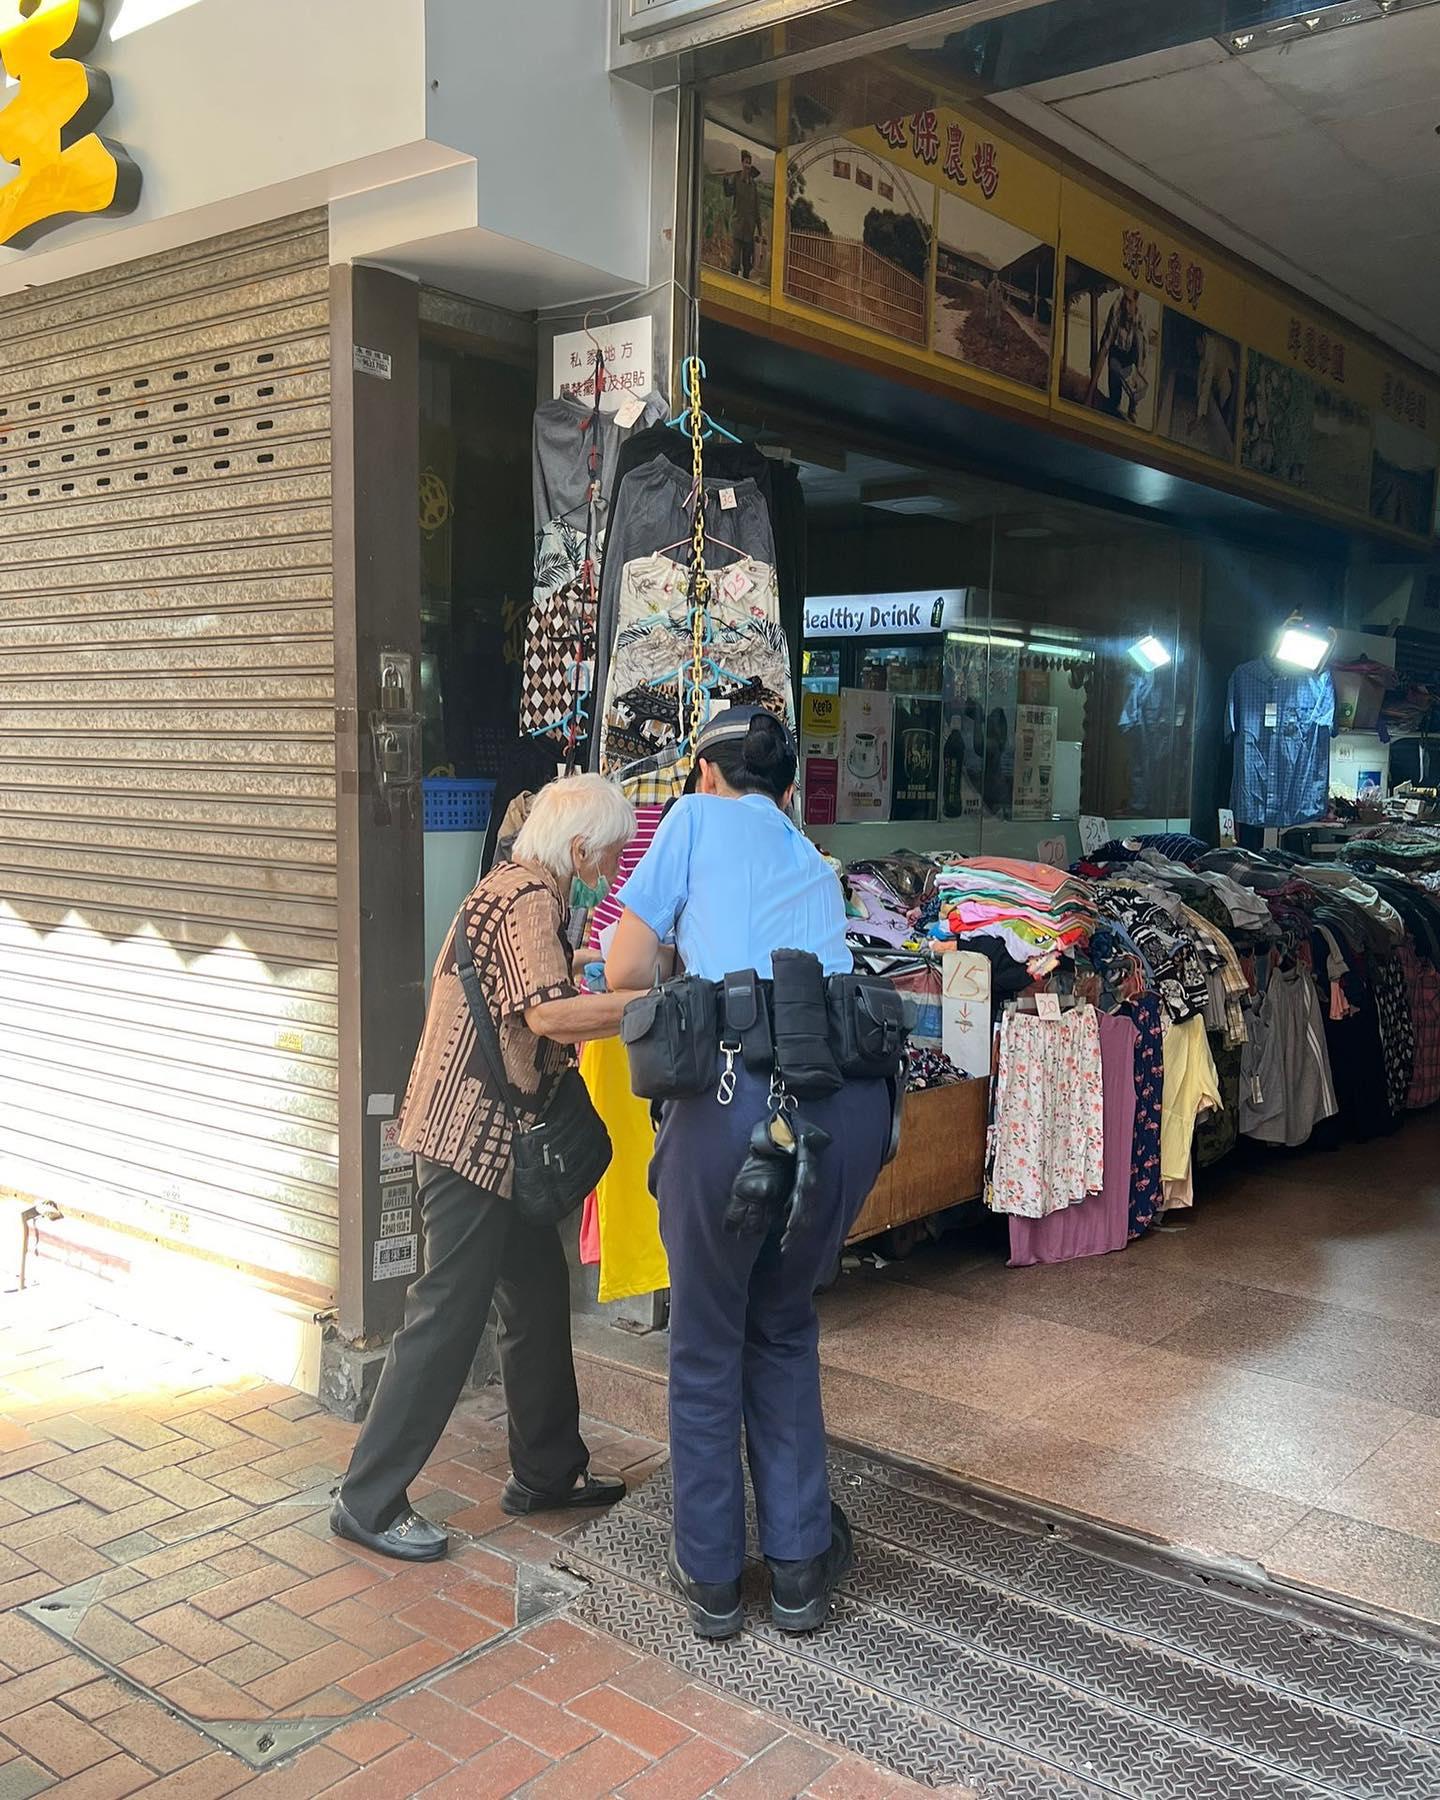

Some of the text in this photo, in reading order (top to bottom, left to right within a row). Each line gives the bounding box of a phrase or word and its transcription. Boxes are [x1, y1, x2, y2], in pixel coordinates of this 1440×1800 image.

[570, 343, 633, 368] 私家地方
[870, 603, 921, 627] Drink
[946, 960, 985, 998] 15
[1040, 1000, 1057, 1016] 20
